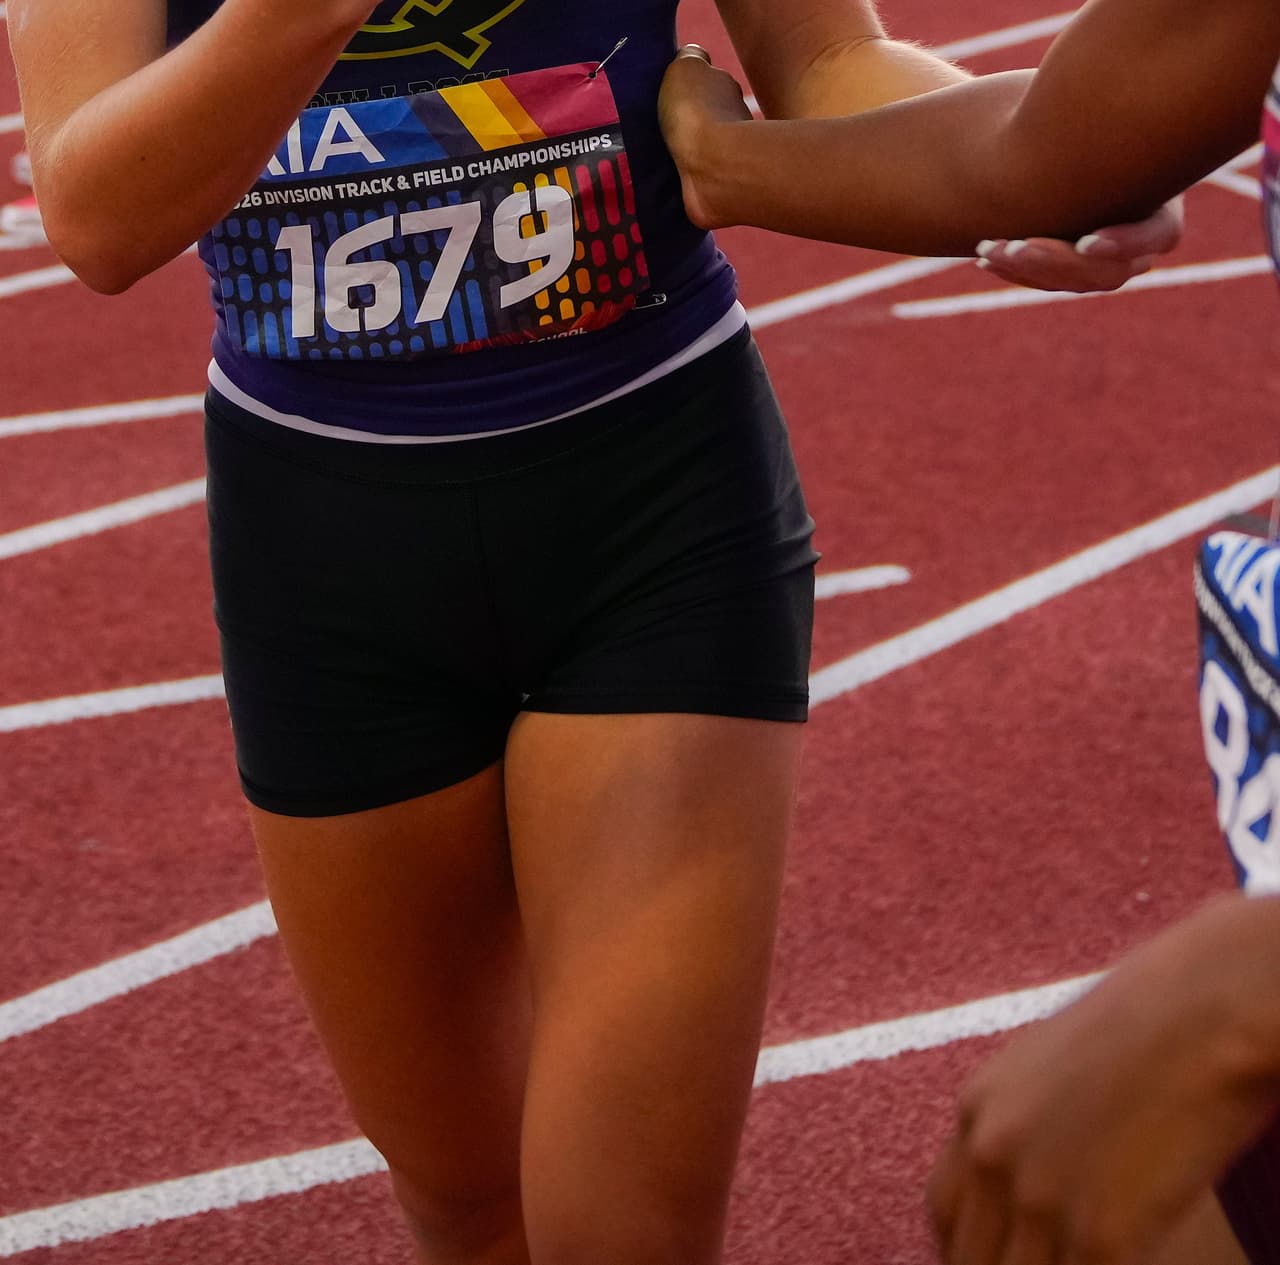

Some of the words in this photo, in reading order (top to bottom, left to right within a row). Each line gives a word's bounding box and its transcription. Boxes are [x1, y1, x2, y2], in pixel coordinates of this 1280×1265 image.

[265, 186, 333, 206] DIVISION
[335, 177, 395, 200] TRACK
[396, 174, 411, 190] &
[413, 166, 465, 188] FIELD
[467, 133, 613, 178] CHAMPIONSHIPS
[267, 107, 385, 176] IA
[274, 184, 575, 338] 1679
